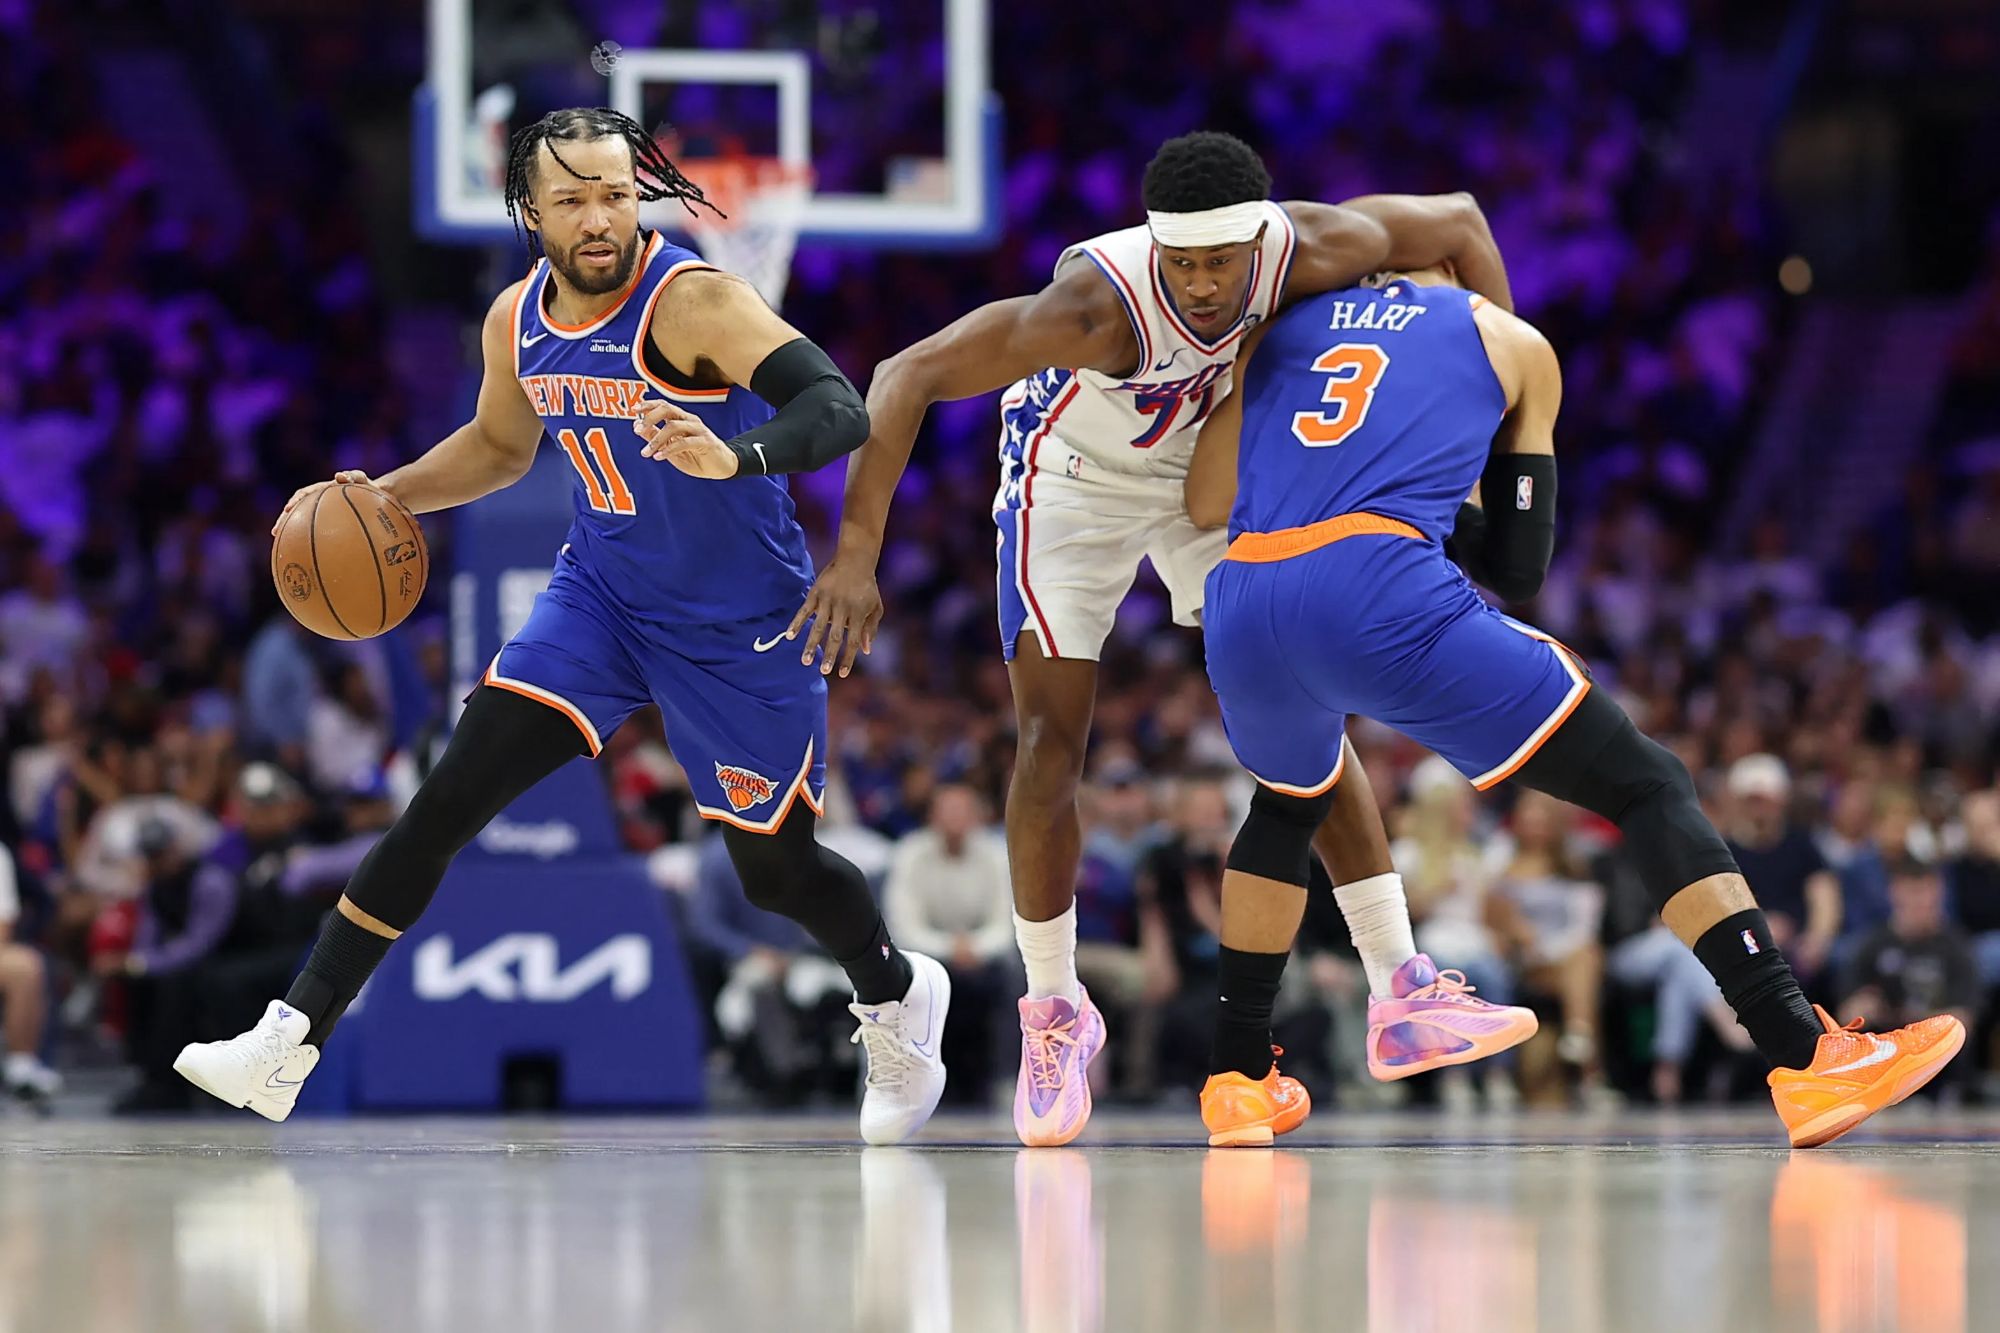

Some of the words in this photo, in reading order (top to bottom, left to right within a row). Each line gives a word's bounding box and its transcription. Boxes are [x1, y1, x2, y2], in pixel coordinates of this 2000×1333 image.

[1329, 301, 1427, 331] HART
[590, 344, 604, 353] abu
[605, 344, 630, 353] dhabi
[565, 375, 650, 420] YORK
[1291, 342, 1390, 447] 3
[557, 428, 637, 515] 11
[719, 768, 770, 798] KNICKS
[413, 933, 652, 1001] KIA
